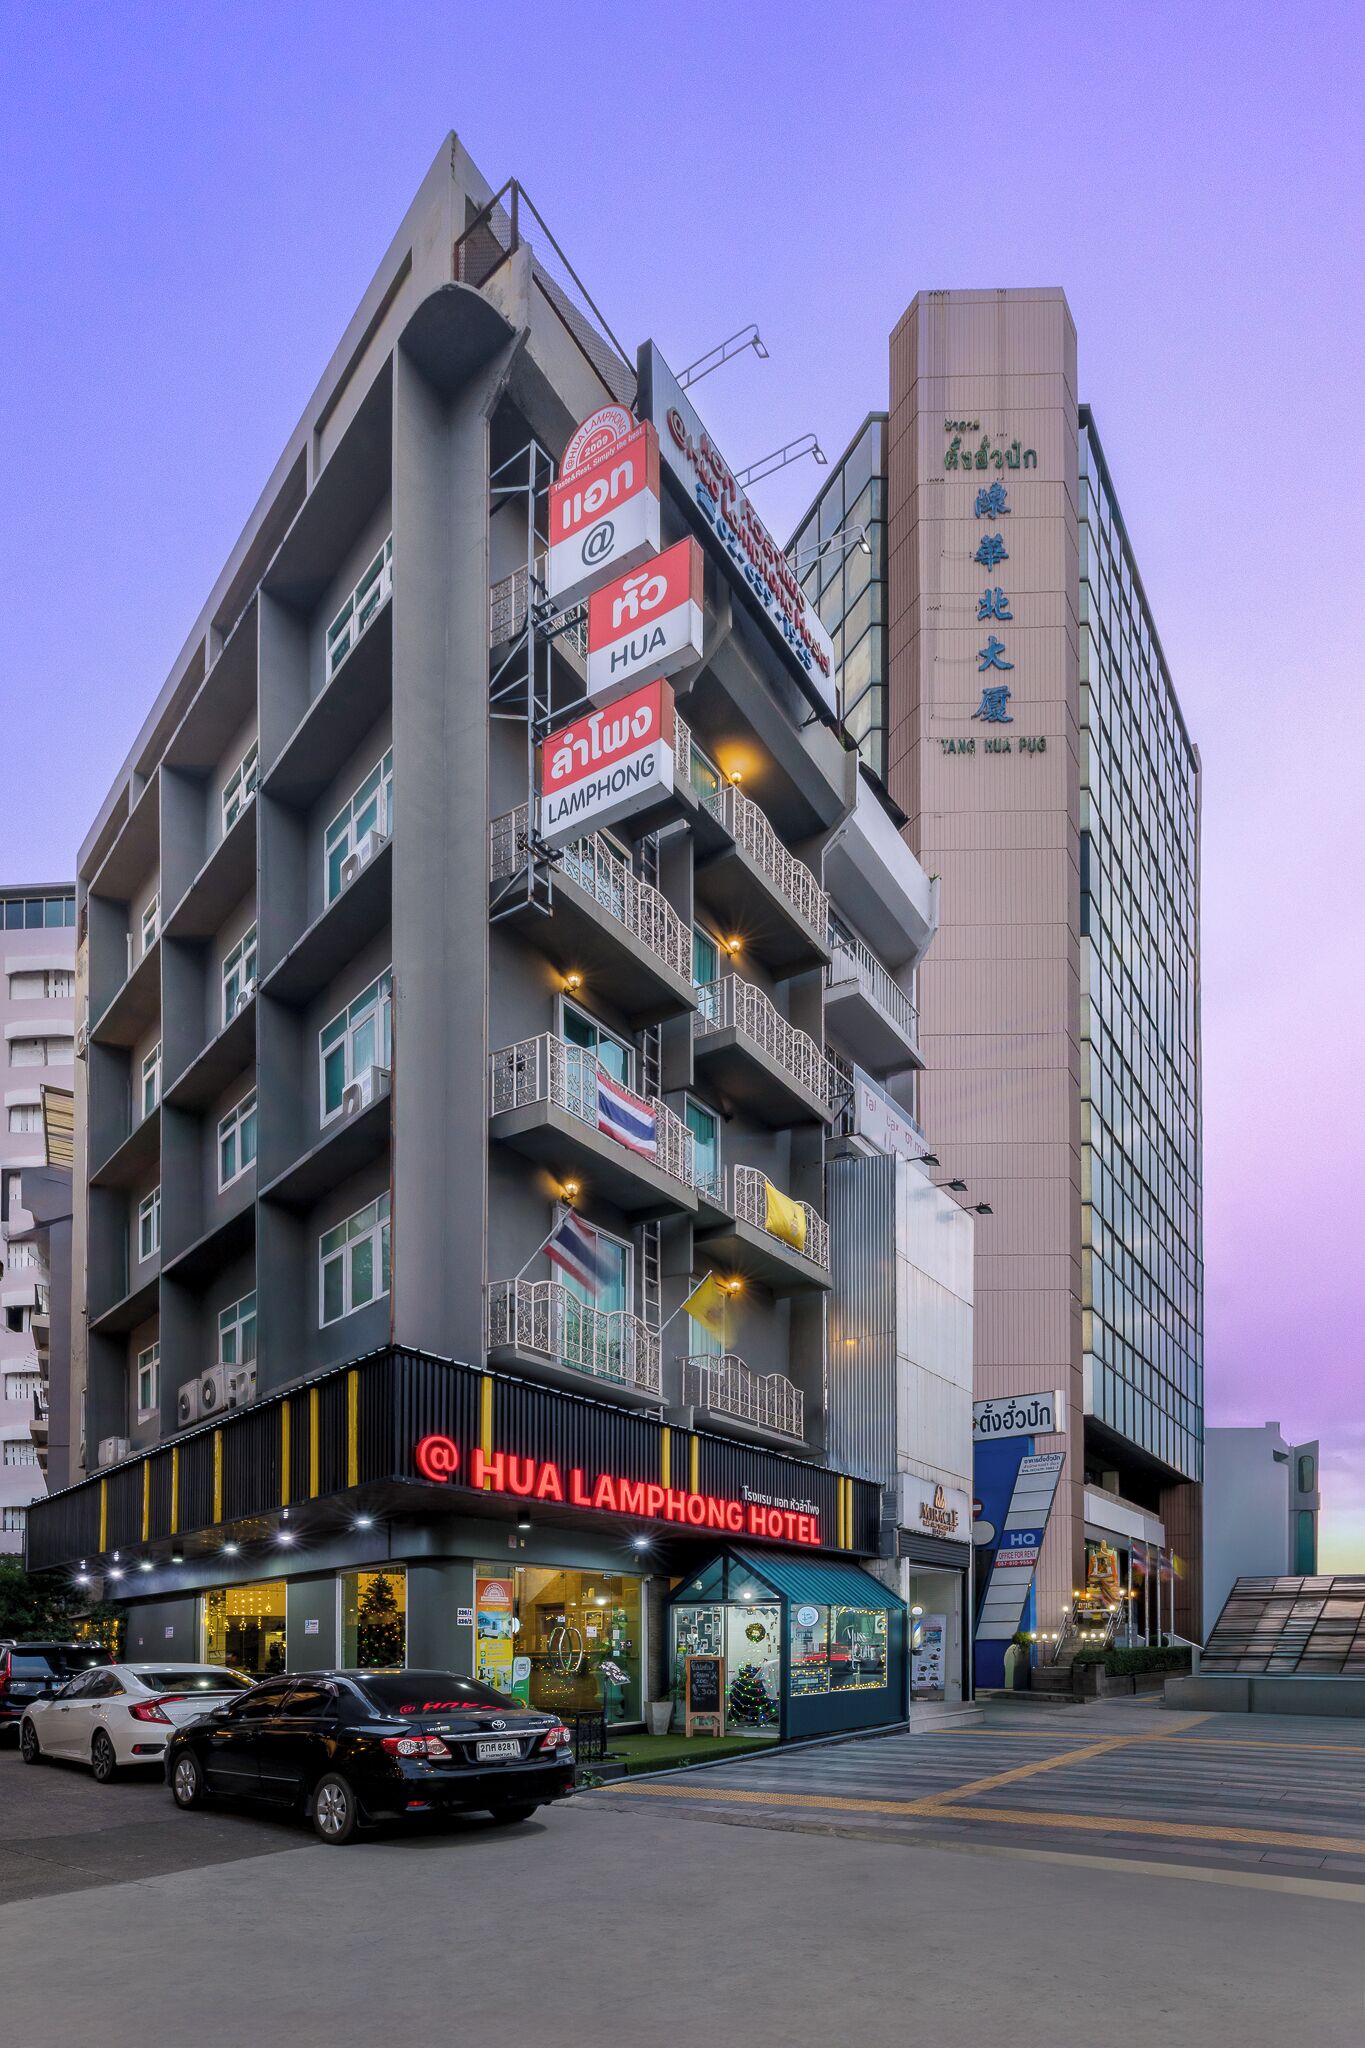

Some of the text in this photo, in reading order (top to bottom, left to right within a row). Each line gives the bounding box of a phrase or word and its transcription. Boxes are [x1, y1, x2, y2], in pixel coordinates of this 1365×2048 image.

[584, 411, 627, 435] LAMPHONG
[584, 435, 609, 457] 2009
[592, 446, 616, 466] Simply
[581, 520, 615, 566] @
[612, 572, 668, 629] หัว
[610, 627, 667, 674] HUA
[550, 705, 653, 780] ลำโพง
[984, 737, 1012, 754] HUA
[547, 752, 655, 825] LAMPHONG
[979, 1401, 1051, 1434] ตั้งฮั่วปัก
[416, 1434, 822, 1544] @ HUA LAMPHONG HOTEL
[741, 1485, 819, 1515] โรงแรม แอท หัวลำโพง
[919, 1502, 959, 1527] MIRACLE
[1010, 1533, 1035, 1546] HQ
[999, 1550, 1036, 1560] OFFICE FOR RENT
[498, 1743, 515, 1751] 8281
